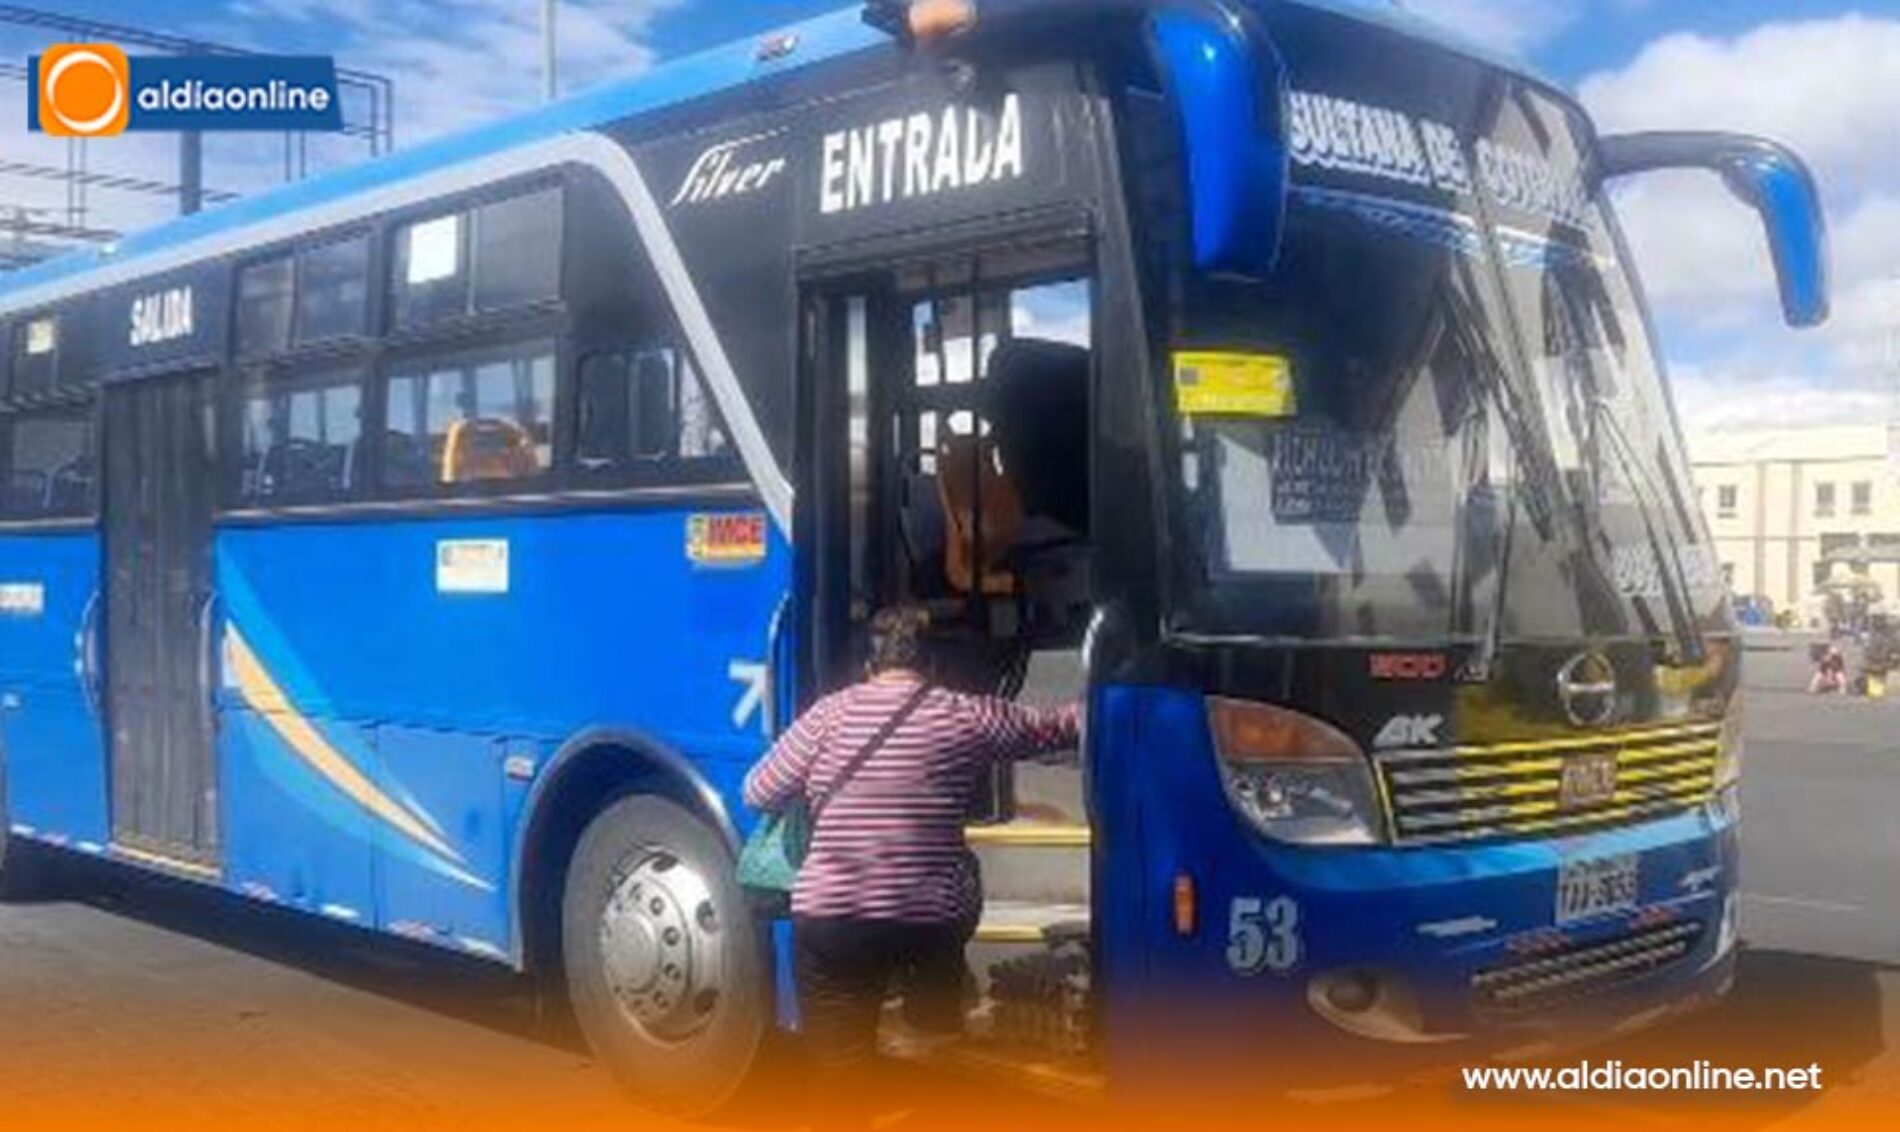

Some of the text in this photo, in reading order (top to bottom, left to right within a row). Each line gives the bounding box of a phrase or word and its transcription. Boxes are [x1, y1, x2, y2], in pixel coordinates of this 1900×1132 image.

[820, 92, 1022, 214] ENTRADA
[1289, 91, 1431, 184] SULTANA
[1226, 896, 1302, 972] 53
